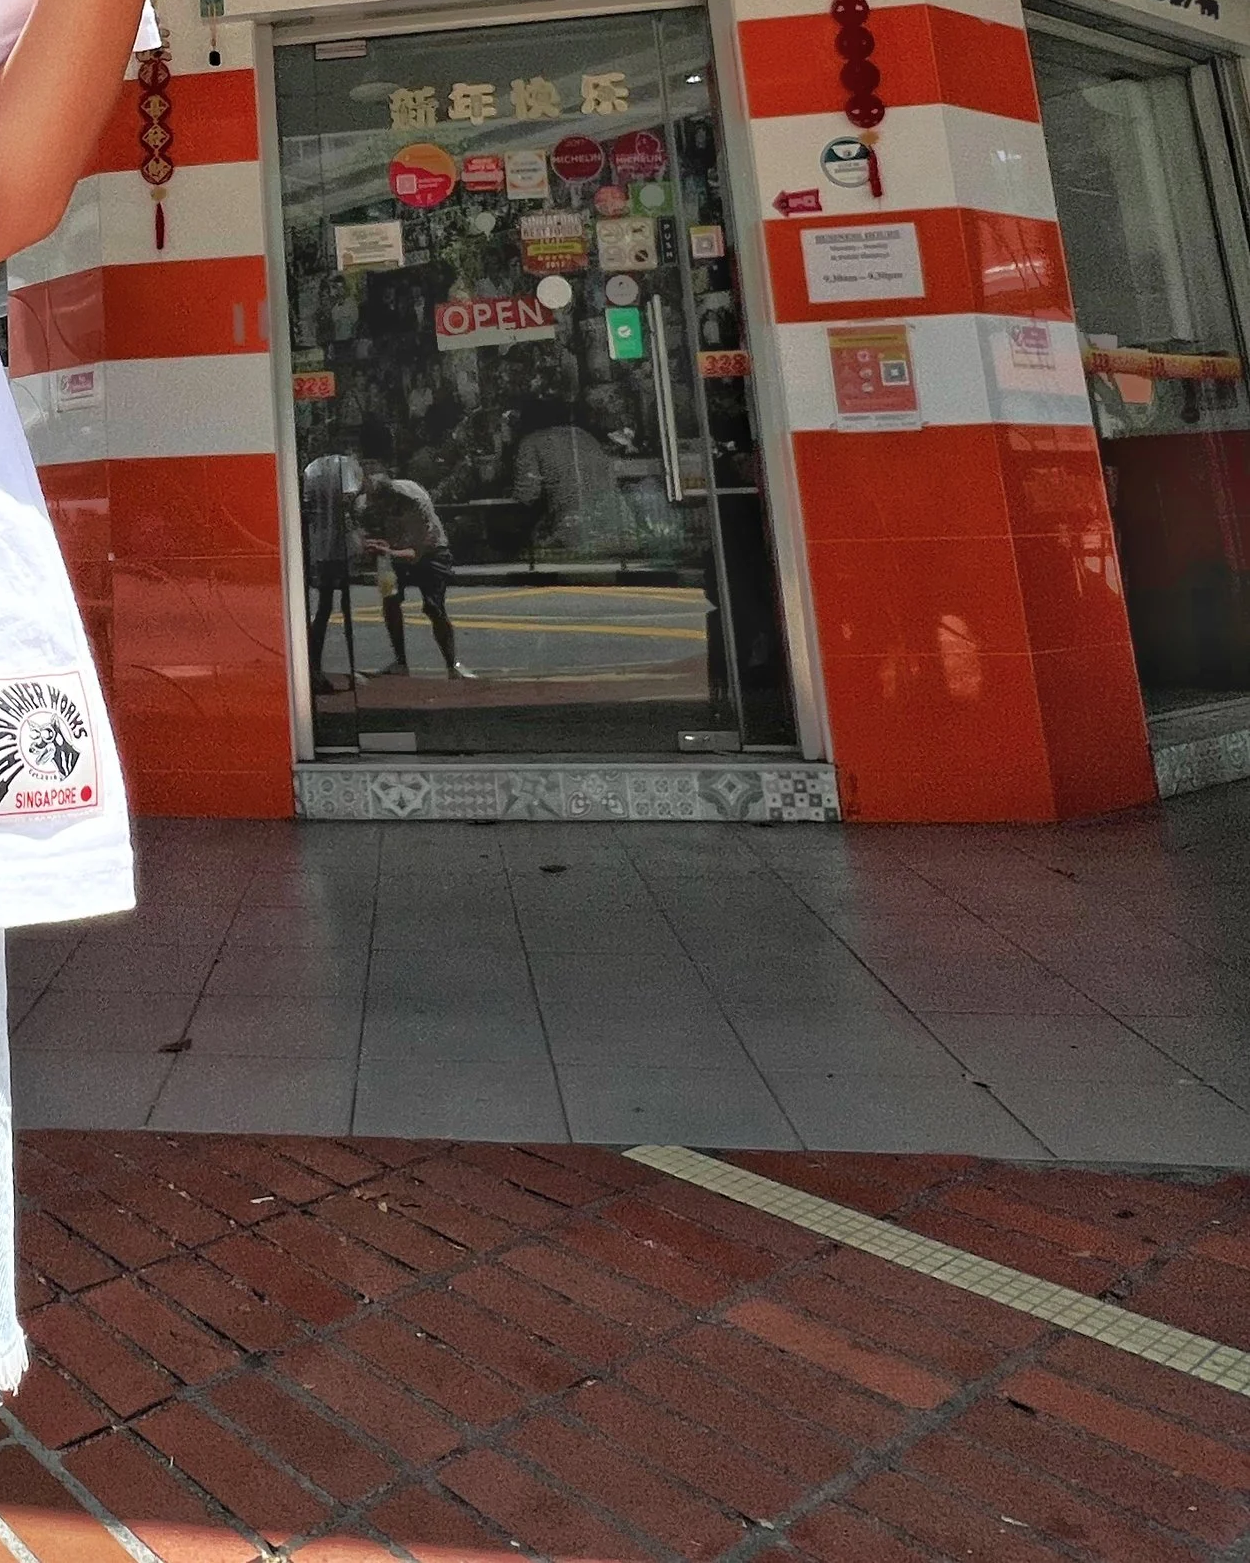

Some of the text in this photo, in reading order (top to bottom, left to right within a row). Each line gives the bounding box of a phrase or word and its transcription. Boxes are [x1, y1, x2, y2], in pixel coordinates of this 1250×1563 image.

[388, 71, 630, 130] 新年快乐
[552, 153, 602, 164] MICHELIN
[662, 223, 674, 259] PUSH
[443, 299, 545, 335] OPEN
[46, 683, 88, 740] WORKS
[15, 786, 78, 810] SINGAPORE
